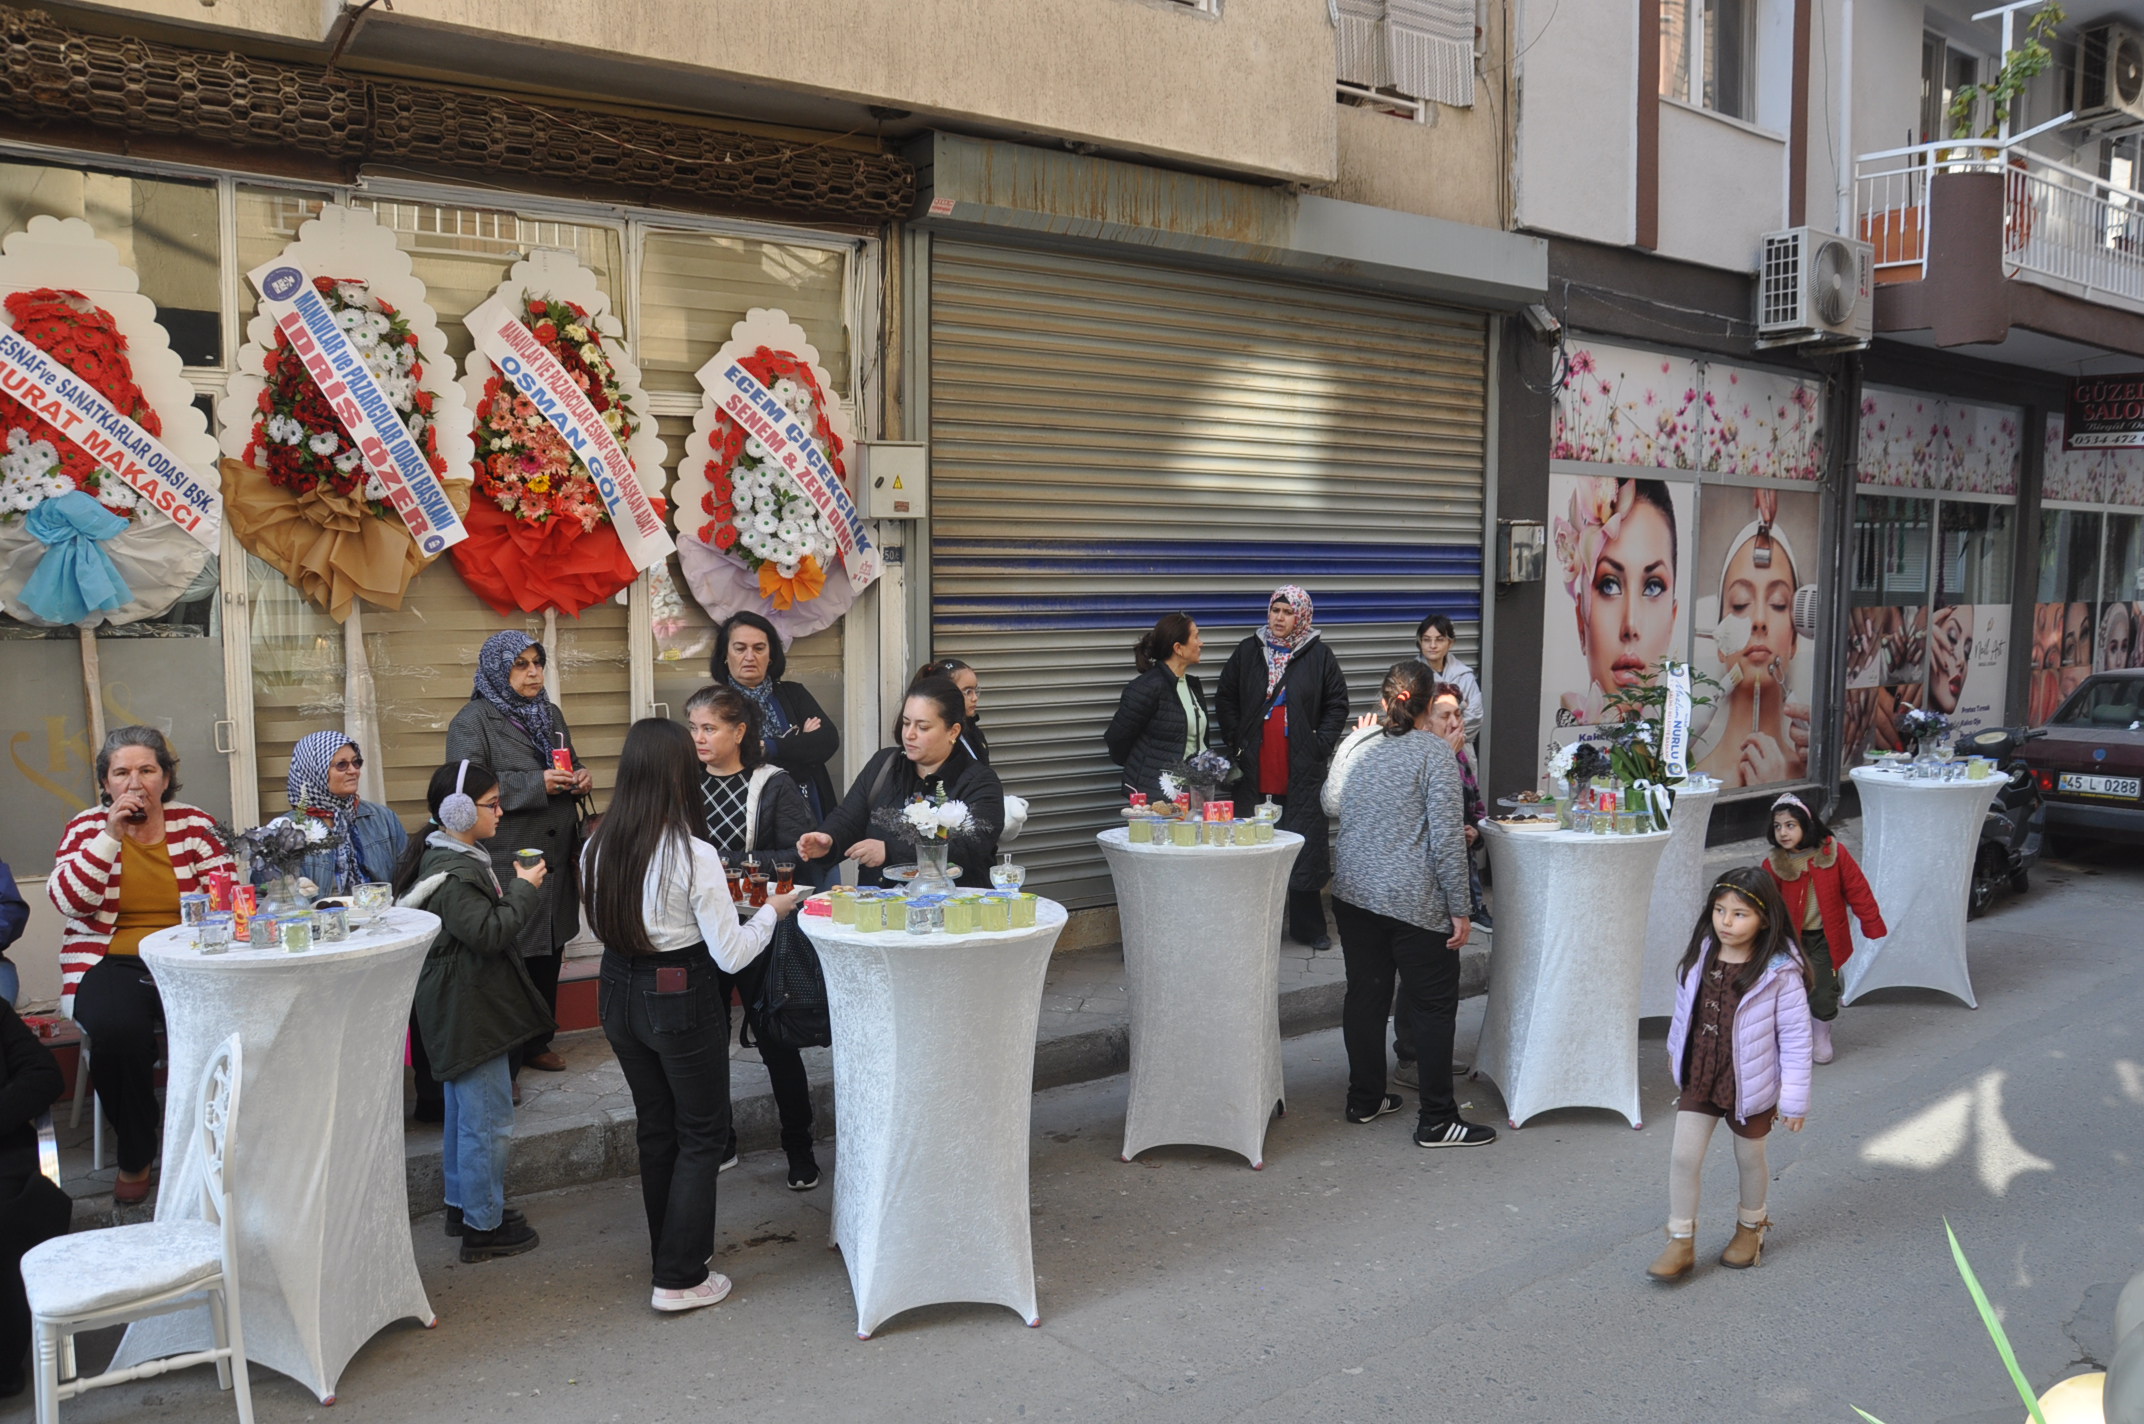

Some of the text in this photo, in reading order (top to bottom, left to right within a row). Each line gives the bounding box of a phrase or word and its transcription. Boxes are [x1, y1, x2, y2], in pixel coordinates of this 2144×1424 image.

[293, 290, 347, 356] MANAVLAR
[497, 320, 545, 367] MANAVLAR
[331, 350, 354, 371] ve
[535, 358, 556, 378] VE
[342, 366, 404, 445] PAZARCILAR
[544, 369, 595, 426] PAZARCILAR
[56, 379, 152, 459] SANATKARLAR
[147, 452, 189, 490] ODASI
[183, 483, 215, 514] BŞK.
[280, 312, 429, 536] İDRİS ÖZER
[501, 356, 621, 517] OSMAN GÖL
[584, 417, 614, 452] ESNAF
[389, 440, 427, 482] ODASI
[603, 448, 628, 480] ODASI
[723, 365, 872, 556] ECEM ÇİÇEKÇİLİK
[725, 394, 788, 454] SENEM
[782, 452, 798, 470] &
[795, 465, 833, 511] ZEKİ
[81, 429, 202, 532] MAKASCI
[634, 508, 660, 538] ADAYI
[1670, 720, 1682, 759] NURLU
[2067, 776, 2137, 794] 45 L 0288
